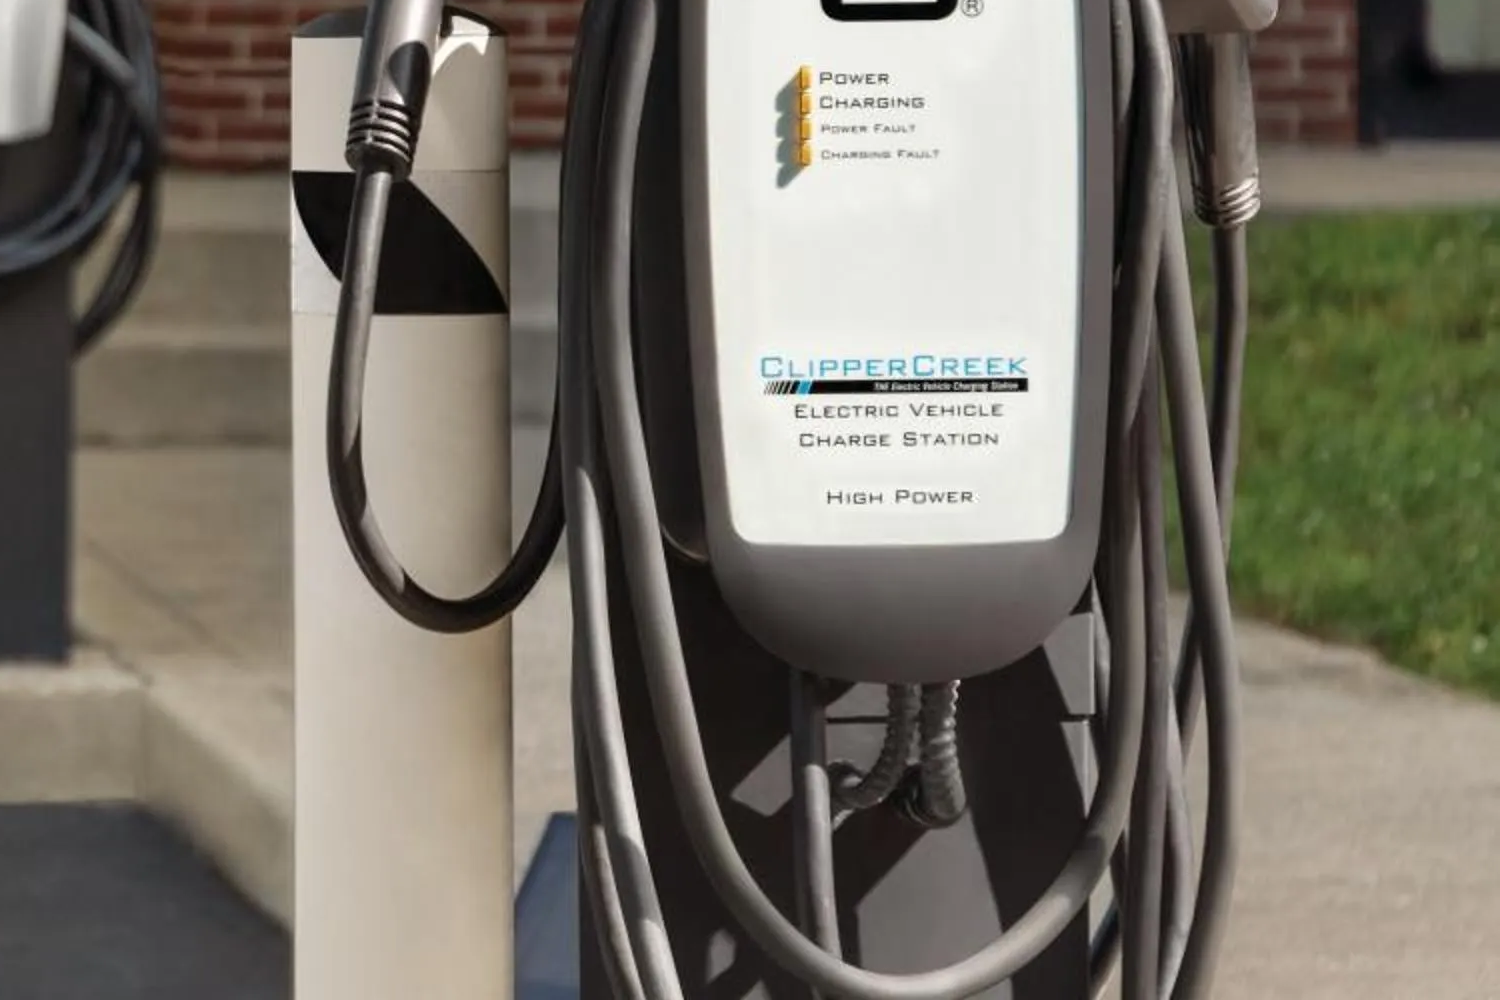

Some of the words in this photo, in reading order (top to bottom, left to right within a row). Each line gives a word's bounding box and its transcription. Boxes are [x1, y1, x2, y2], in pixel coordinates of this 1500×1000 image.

[819, 71, 890, 85] POWER
[819, 95, 926, 110] CHARGING
[820, 123, 868, 134] POWER
[873, 123, 916, 134] FAULT
[820, 149, 892, 160] CHARGING
[897, 149, 940, 160] FAULT
[794, 403, 900, 419] ELECTRIC
[909, 402, 1004, 418] VEHICLE
[798, 432, 891, 448] CHARGE
[902, 431, 1000, 447] STATION
[826, 490, 883, 505] HIGH
[895, 489, 974, 504] POWER
